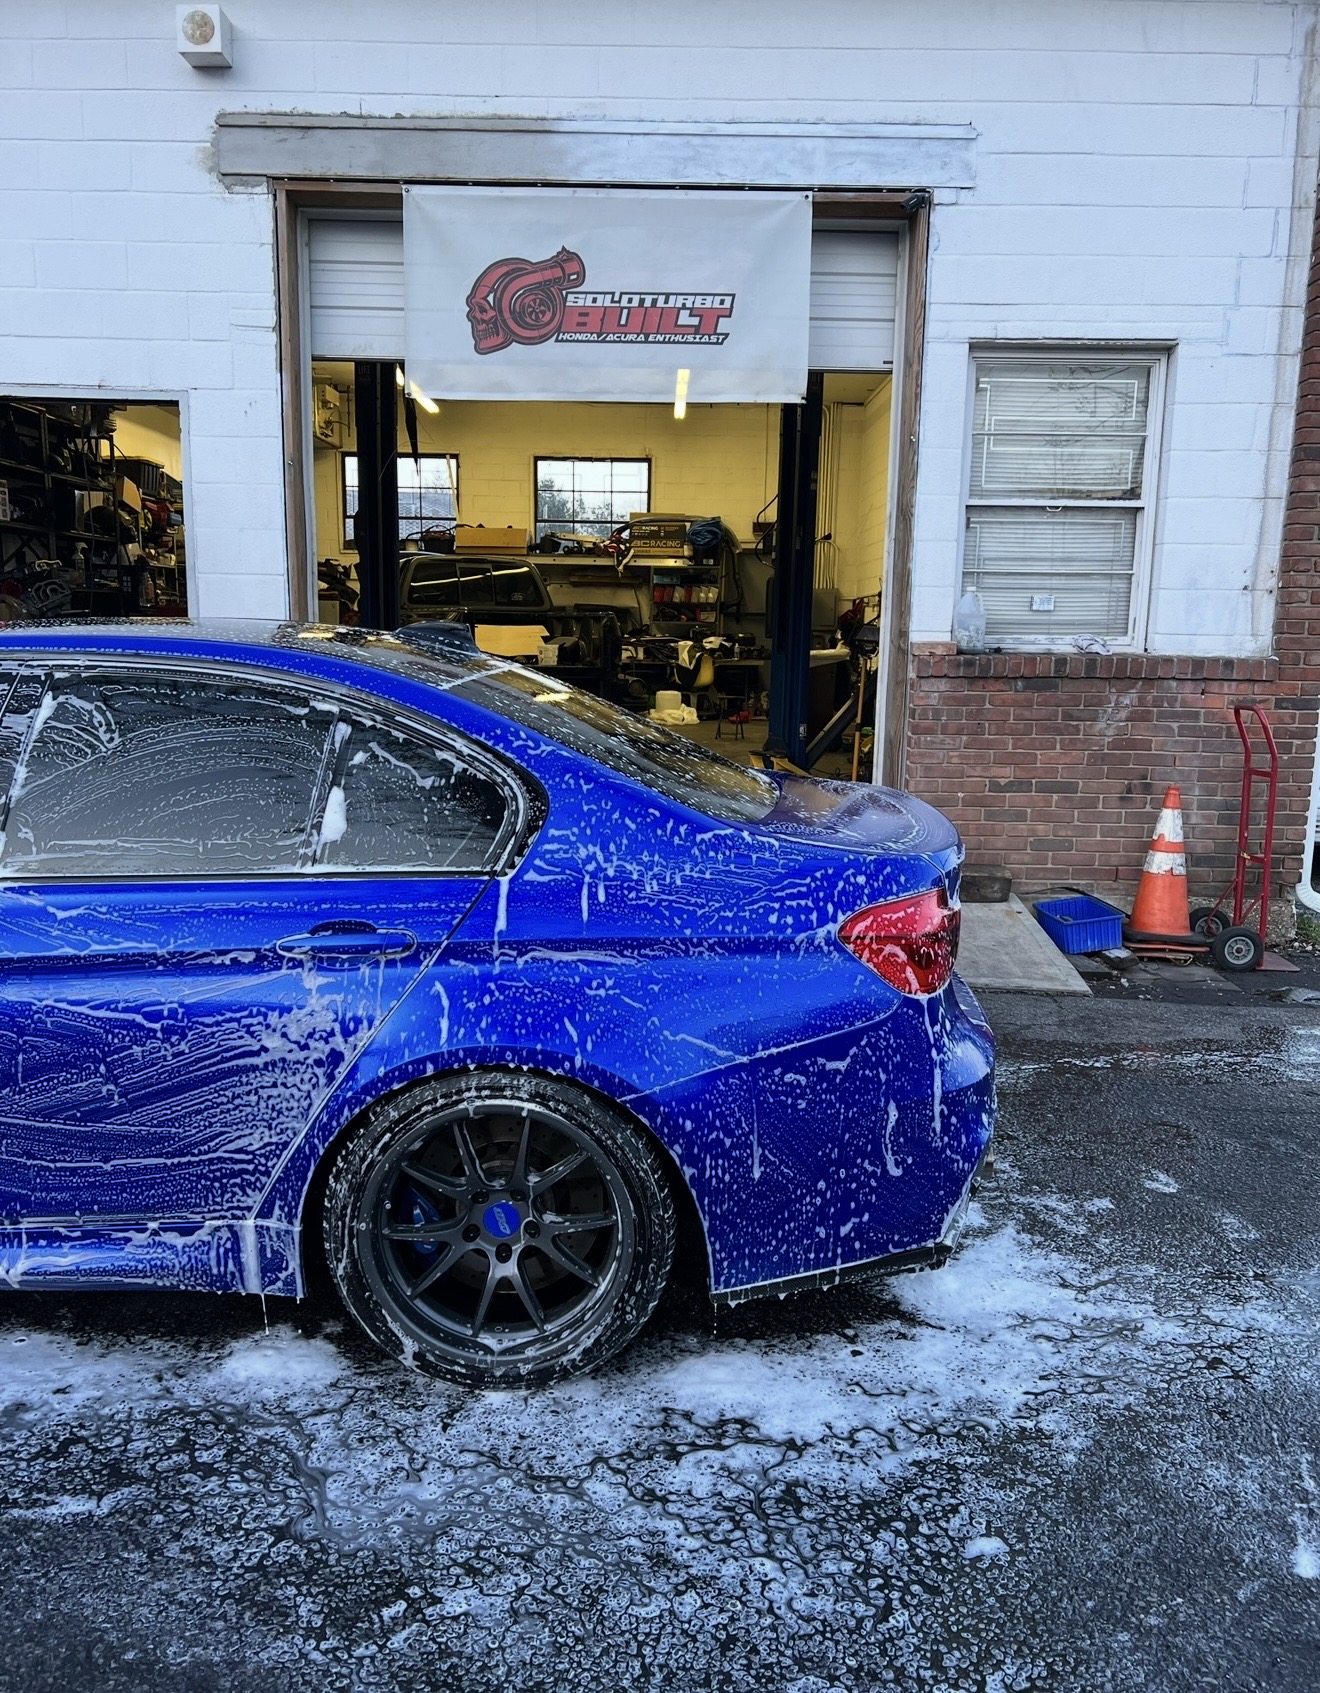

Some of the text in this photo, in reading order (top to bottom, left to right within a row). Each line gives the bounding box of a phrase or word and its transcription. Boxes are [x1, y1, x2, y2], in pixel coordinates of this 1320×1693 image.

[565, 293, 733, 308] SOLOTURBO
[560, 306, 732, 334] BUILT
[558, 333, 726, 343] HONDA/ACURA ENTHUSIAST
[650, 540, 681, 548] RACING
